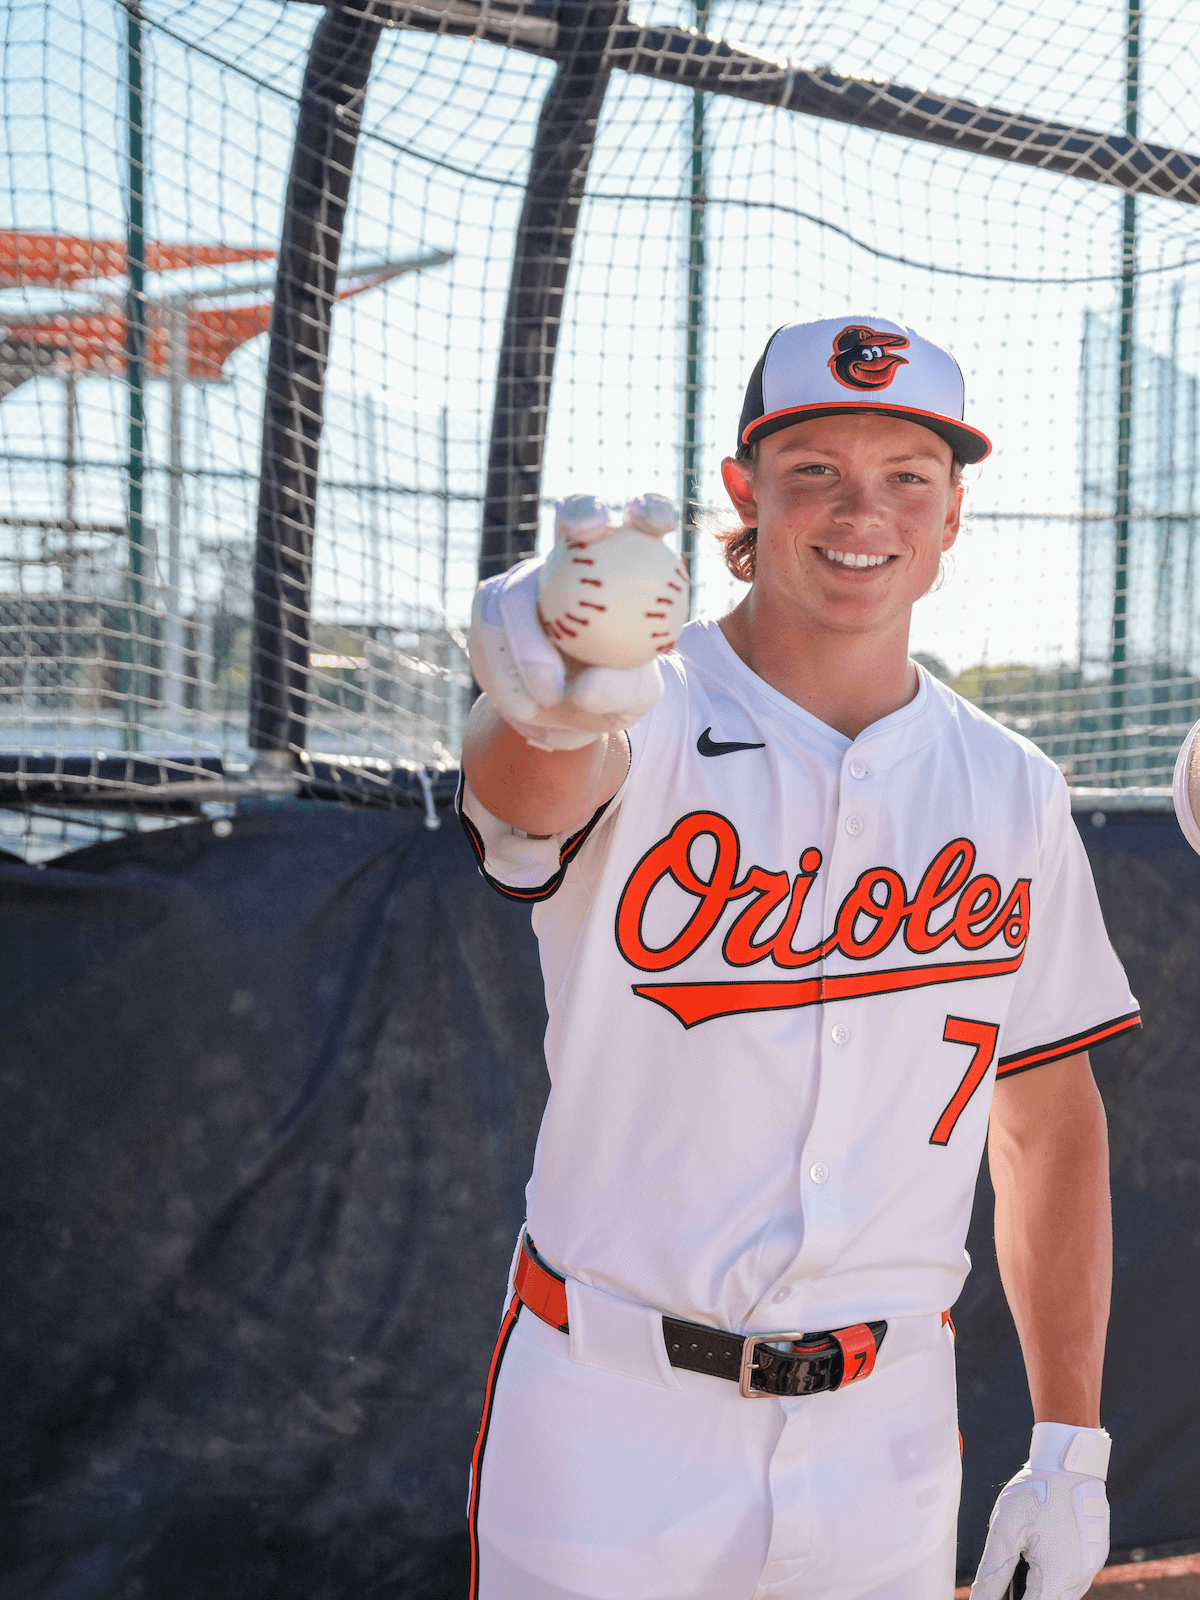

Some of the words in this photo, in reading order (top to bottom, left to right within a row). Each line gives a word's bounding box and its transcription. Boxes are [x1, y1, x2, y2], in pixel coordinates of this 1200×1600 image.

[615, 810, 1032, 973] Orioles
[929, 1014, 1001, 1146] 7
[852, 1352, 867, 1380] 7
